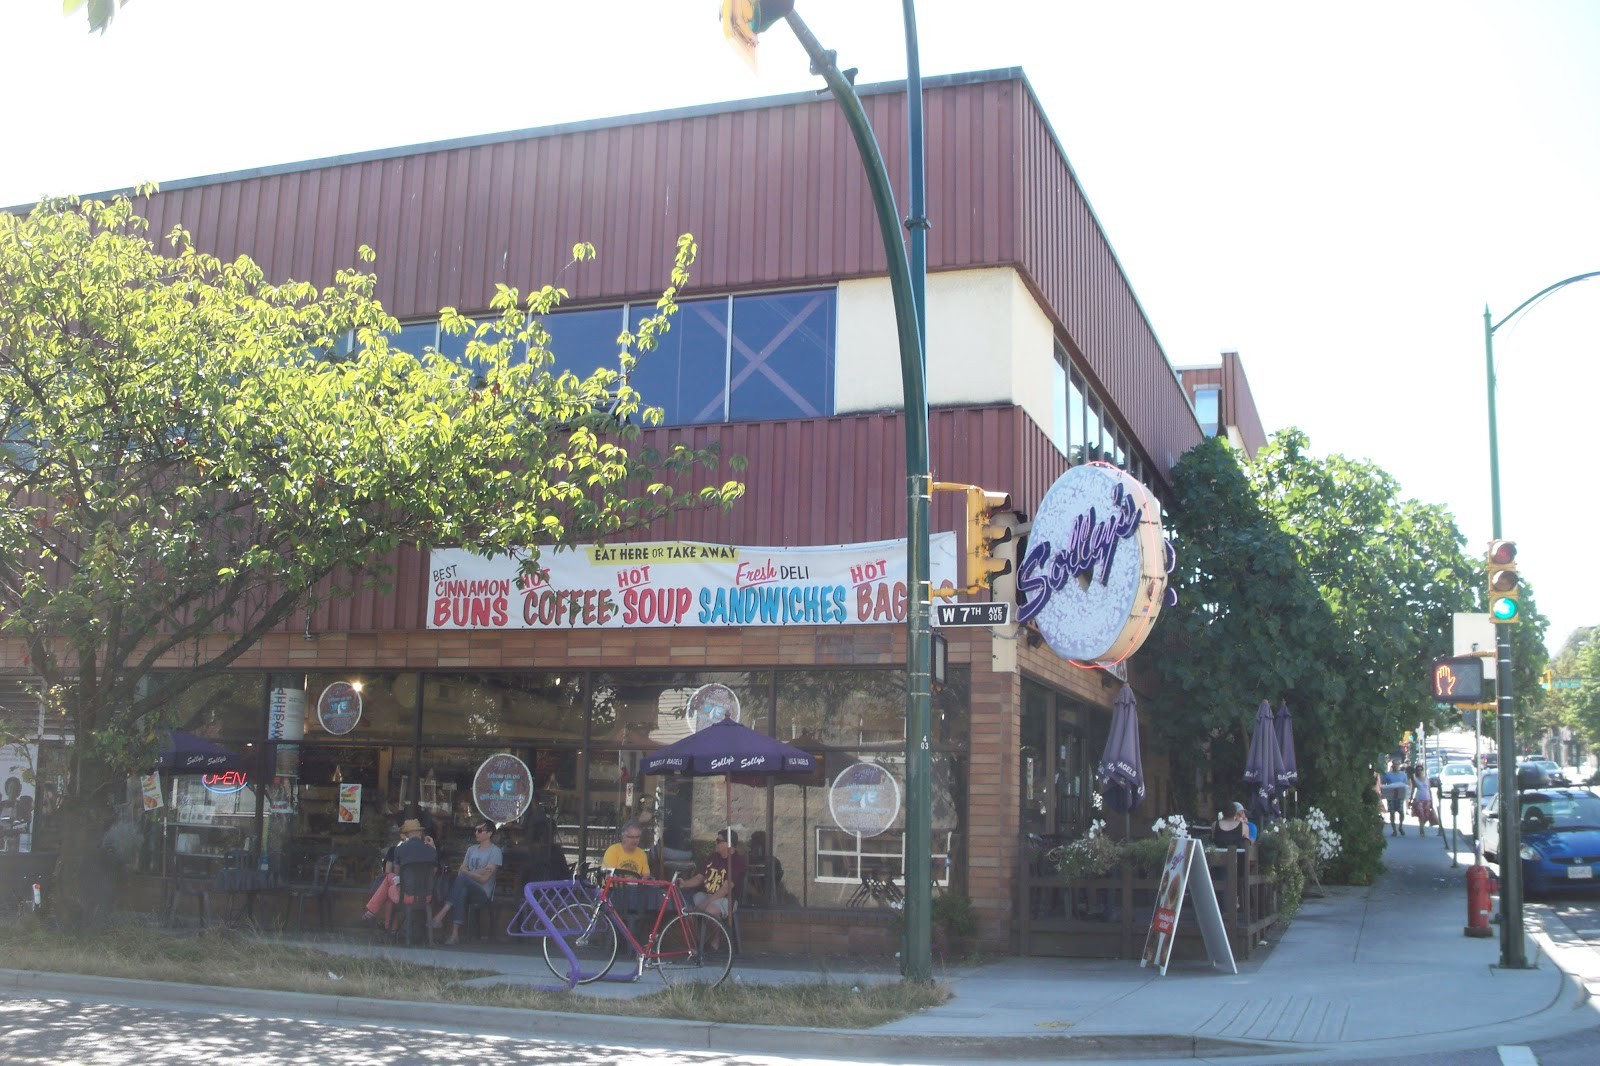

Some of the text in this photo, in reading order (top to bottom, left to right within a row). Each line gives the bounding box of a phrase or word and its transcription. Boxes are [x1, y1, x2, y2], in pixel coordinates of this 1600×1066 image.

[595, 546, 736, 561] EAT HERE OR TAKE AWAY
[1016, 482, 1142, 622] Solly's
[433, 565, 457, 582] BEST
[617, 565, 651, 588] HOT
[735, 558, 809, 585] Fresh DELI
[849, 558, 887, 584] HOT
[435, 578, 510, 597] CINNAMON
[433, 597, 508, 627] BUNS
[523, 588, 613, 626] COFFEE
[622, 587, 692, 625] SOUP
[698, 584, 847, 624] SANDWICHES
[942, 606, 1003, 623] W 7TH AVE
[988, 613, 1003, 621] 300
[920, 741, 929, 750] 03
[711, 755, 765, 769] Solly's Solly's
